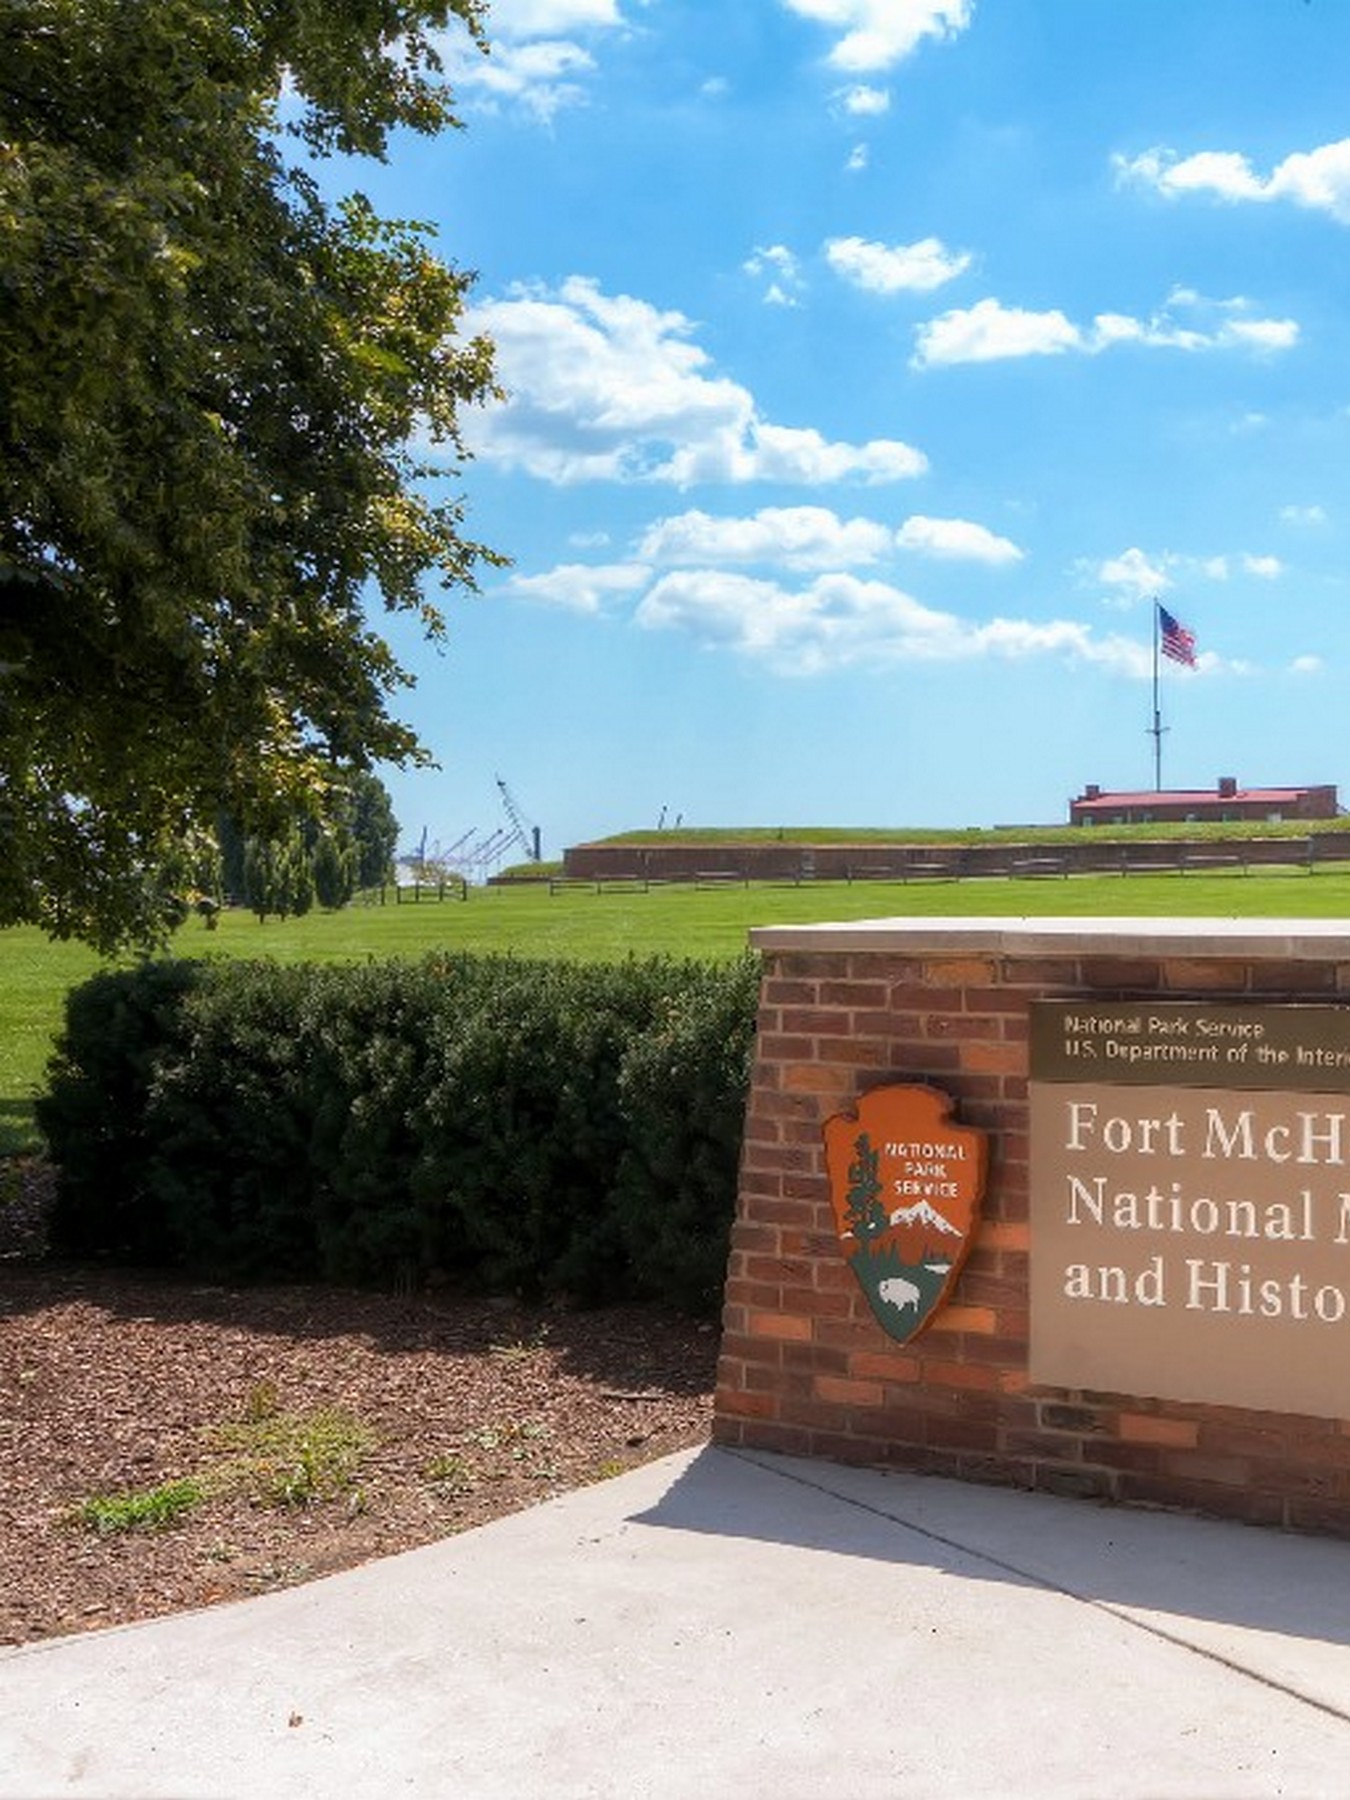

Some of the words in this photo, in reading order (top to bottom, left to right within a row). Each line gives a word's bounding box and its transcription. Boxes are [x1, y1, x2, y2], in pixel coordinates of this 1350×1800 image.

[1064, 1016, 1141, 1034] National
[1149, 1017, 1189, 1036] Park
[1196, 1019, 1264, 1038] Service
[1106, 1041, 1218, 1063] Department
[1227, 1043, 1249, 1062] of
[1255, 1045, 1289, 1064] the
[1065, 1102, 1184, 1155] Fort
[885, 1143, 966, 1160] NATIONAL
[905, 1161, 947, 1178] PARK
[894, 1180, 958, 1198] SERVICE
[1066, 1175, 1314, 1241] National
[1063, 1257, 1166, 1307] and
